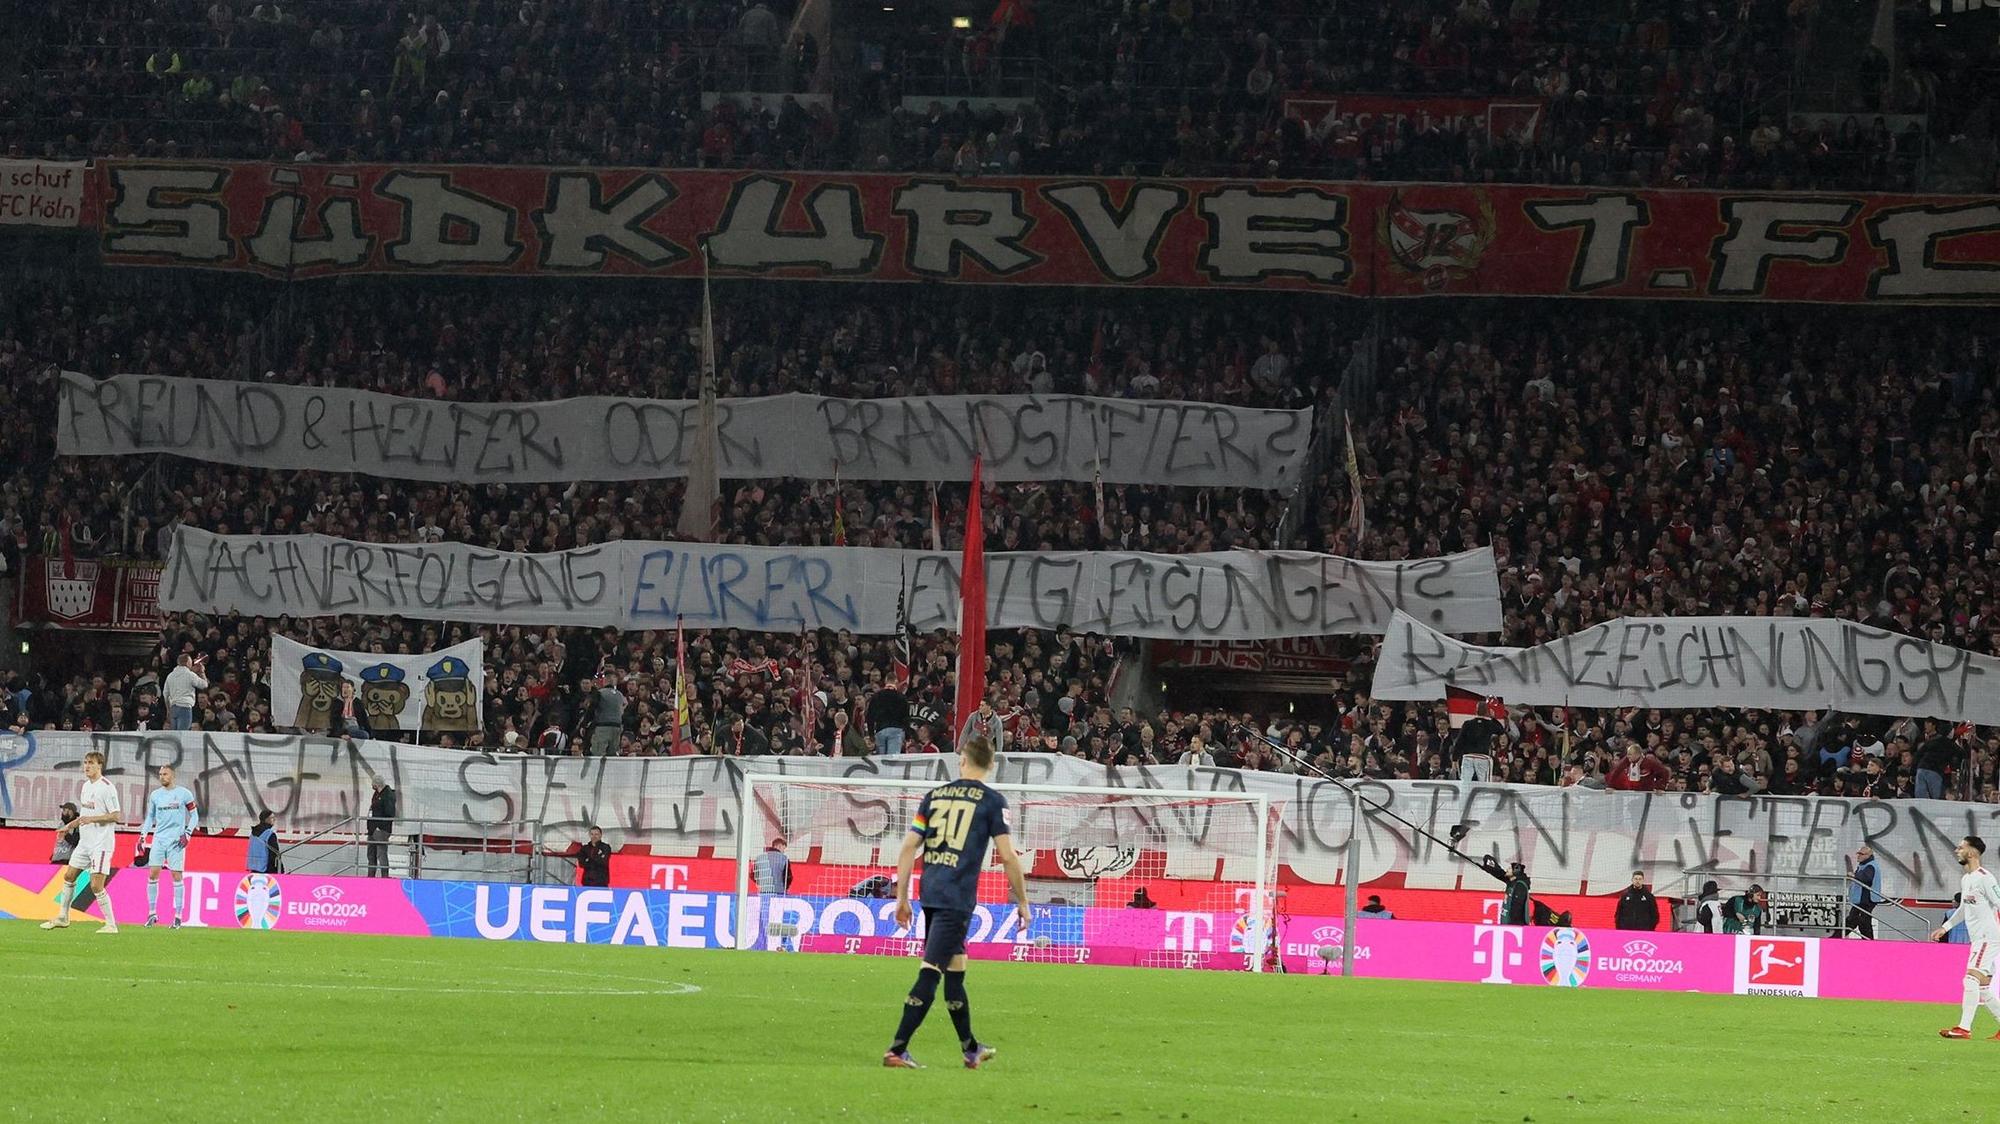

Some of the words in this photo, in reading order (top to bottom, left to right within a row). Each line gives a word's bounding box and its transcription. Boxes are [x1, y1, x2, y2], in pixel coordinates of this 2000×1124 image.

[11, 165, 72, 188] schuf
[30, 195, 75, 218] Köln
[108, 167, 1350, 284] SÜDKURVE
[57, 377, 286, 456] FREUND
[303, 395, 328, 450] &
[342, 400, 566, 476] HELFER
[604, 402, 762, 470] ODER
[168, 526, 606, 611] NACHVERFOLGUNG
[630, 549, 860, 627] EURER
[931, 786, 967, 799] MAINZ
[925, 799, 977, 851] 30
[287, 902, 367, 917] EURO2024
[304, 917, 347, 926] GERMANY
[1473, 925, 1523, 983] T
[1597, 956, 1683, 974] EURO2024
[1615, 973, 1663, 983] GERMANY
[1747, 988, 1804, 997] BUNDESLIGA
